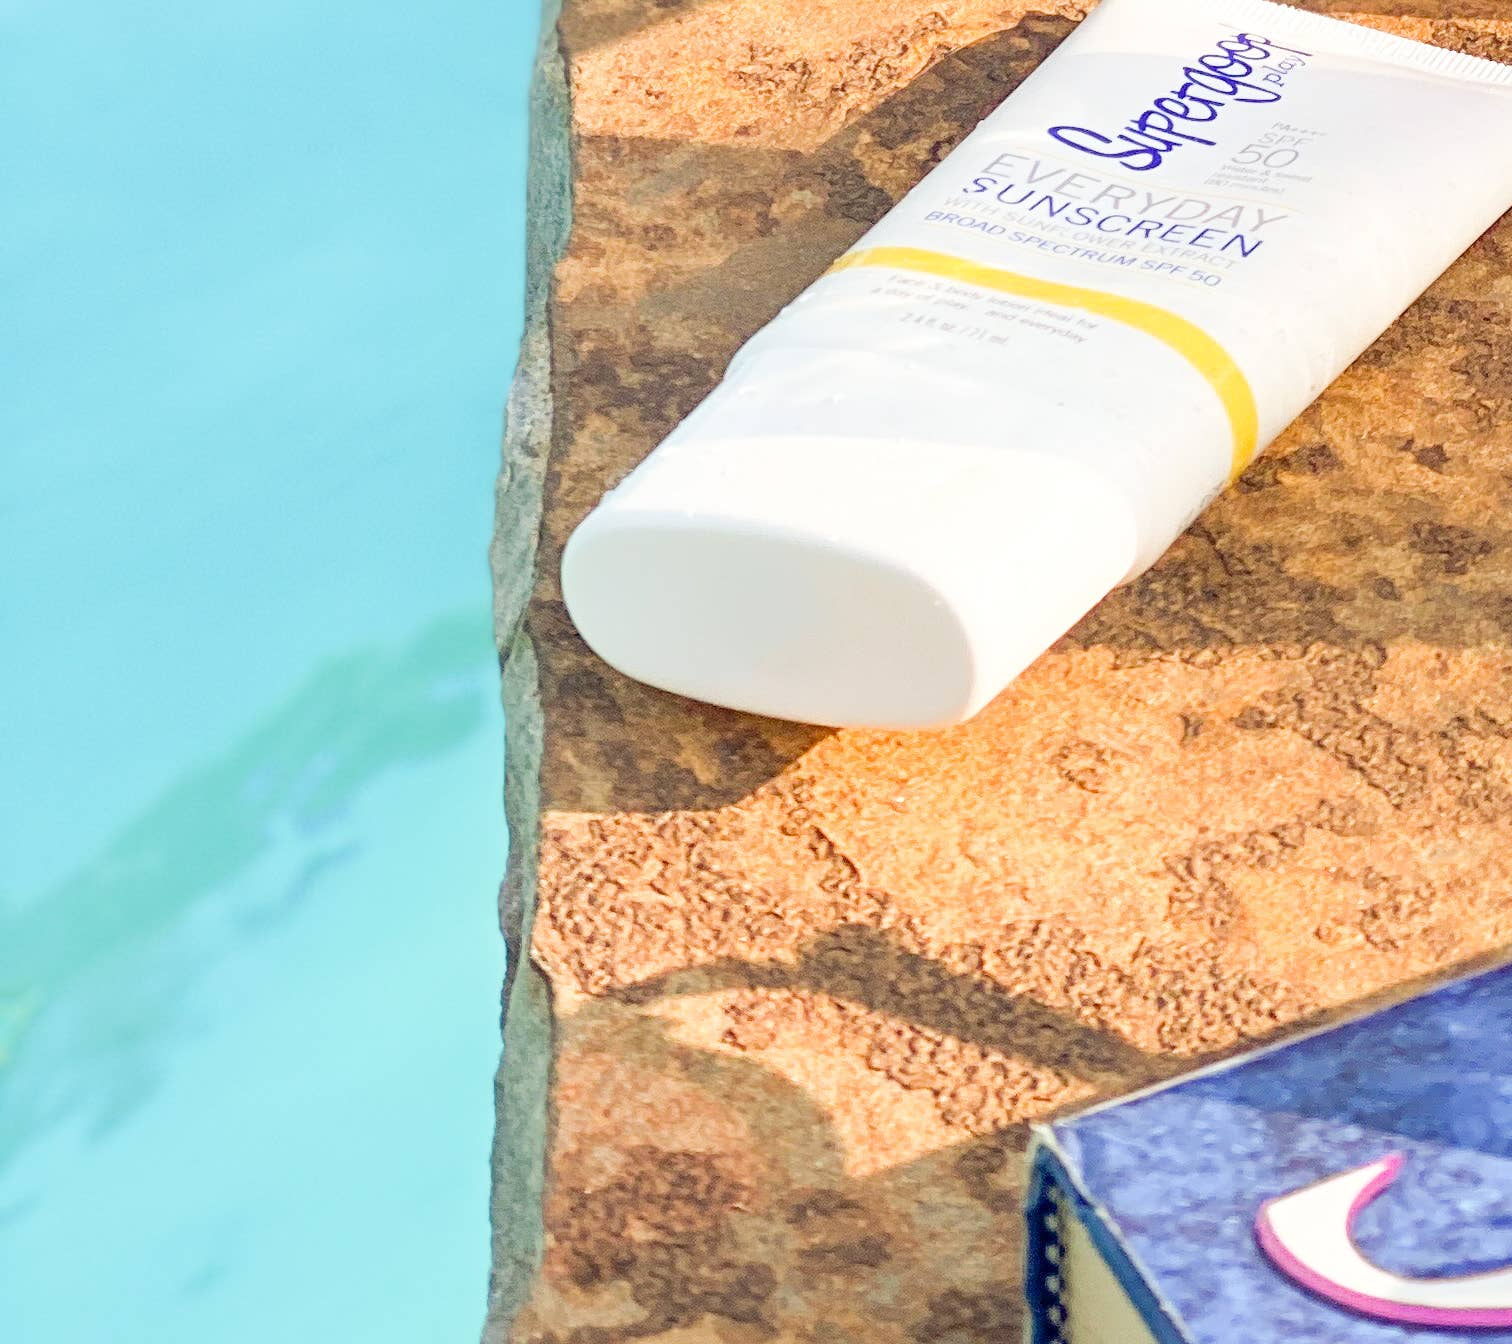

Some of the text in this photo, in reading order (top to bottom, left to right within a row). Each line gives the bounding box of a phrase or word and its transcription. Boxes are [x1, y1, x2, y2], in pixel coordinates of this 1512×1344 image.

[1262, 54, 1307, 88] play
[1231, 143, 1299, 168] 50
[1257, 132, 1314, 146] SPF
[962, 176, 1264, 258] SUNSCREEN
[980, 152, 1289, 232] EVERYDAY
[924, 211, 1223, 288] BROAD SPECTRUM SPF 50
